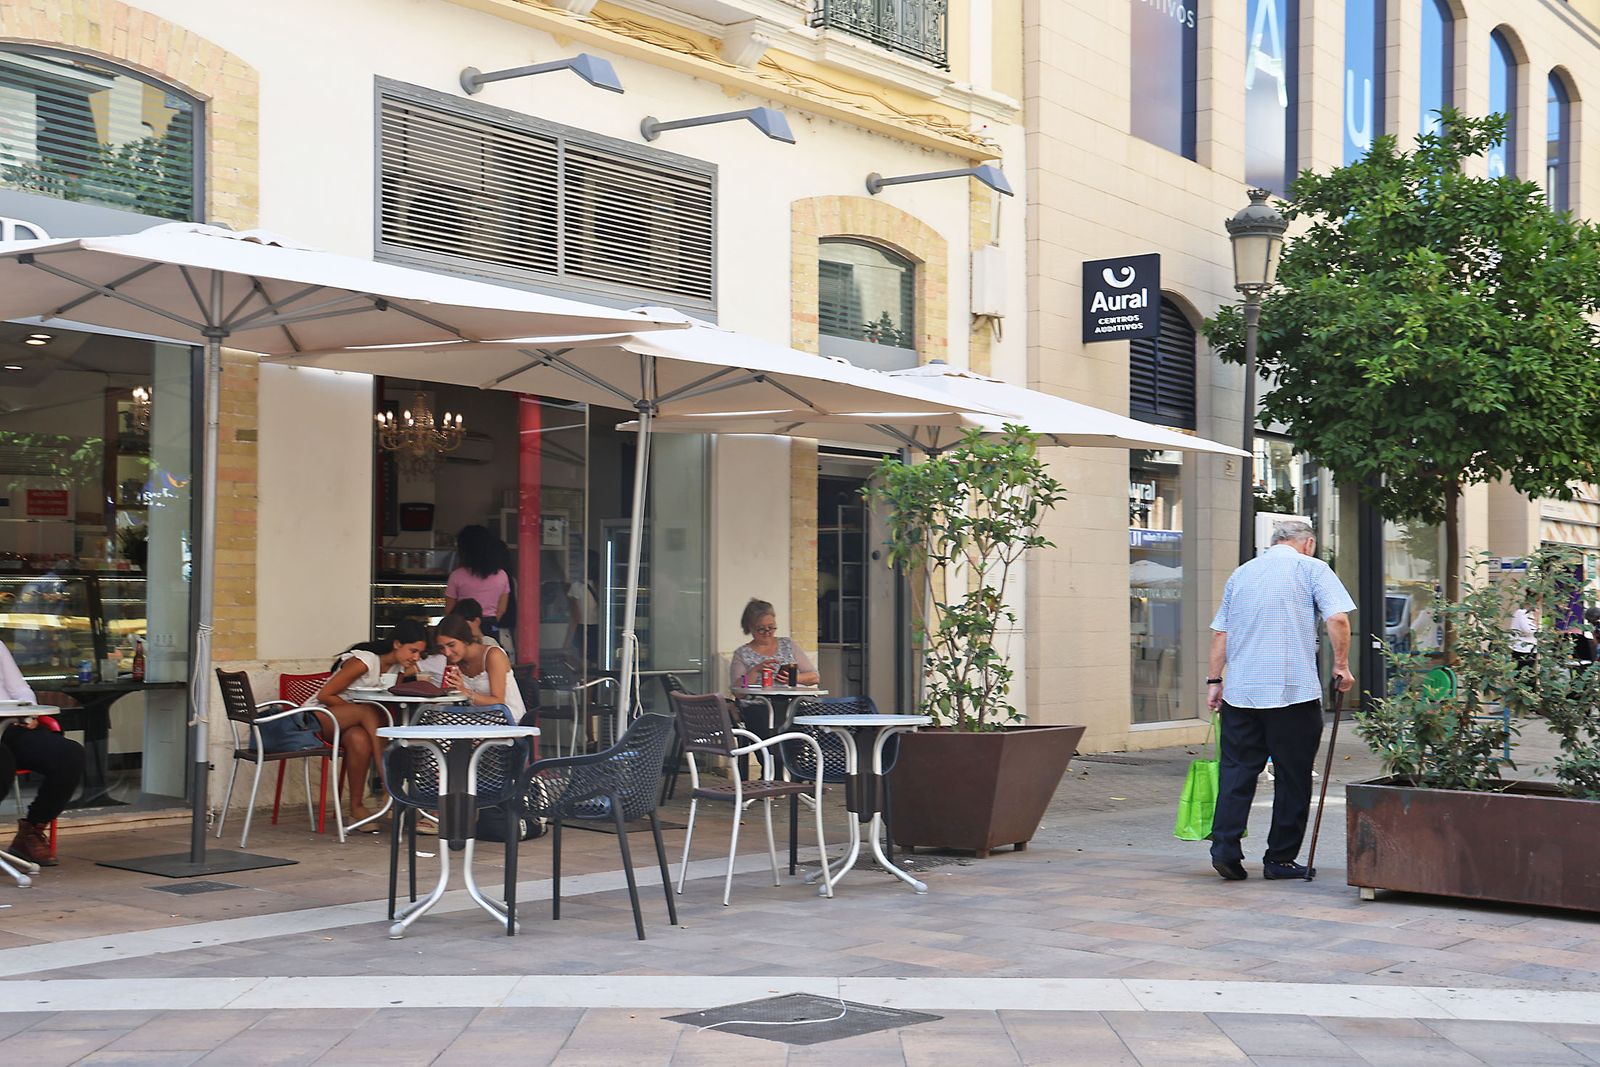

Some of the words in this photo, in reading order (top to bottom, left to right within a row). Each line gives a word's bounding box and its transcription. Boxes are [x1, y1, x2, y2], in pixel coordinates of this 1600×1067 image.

[1090, 287, 1148, 313] Aural
[1098, 314, 1140, 325] CENTROS
[1094, 322, 1144, 334] AUDITIVOS
[1128, 480, 1156, 501] ural
